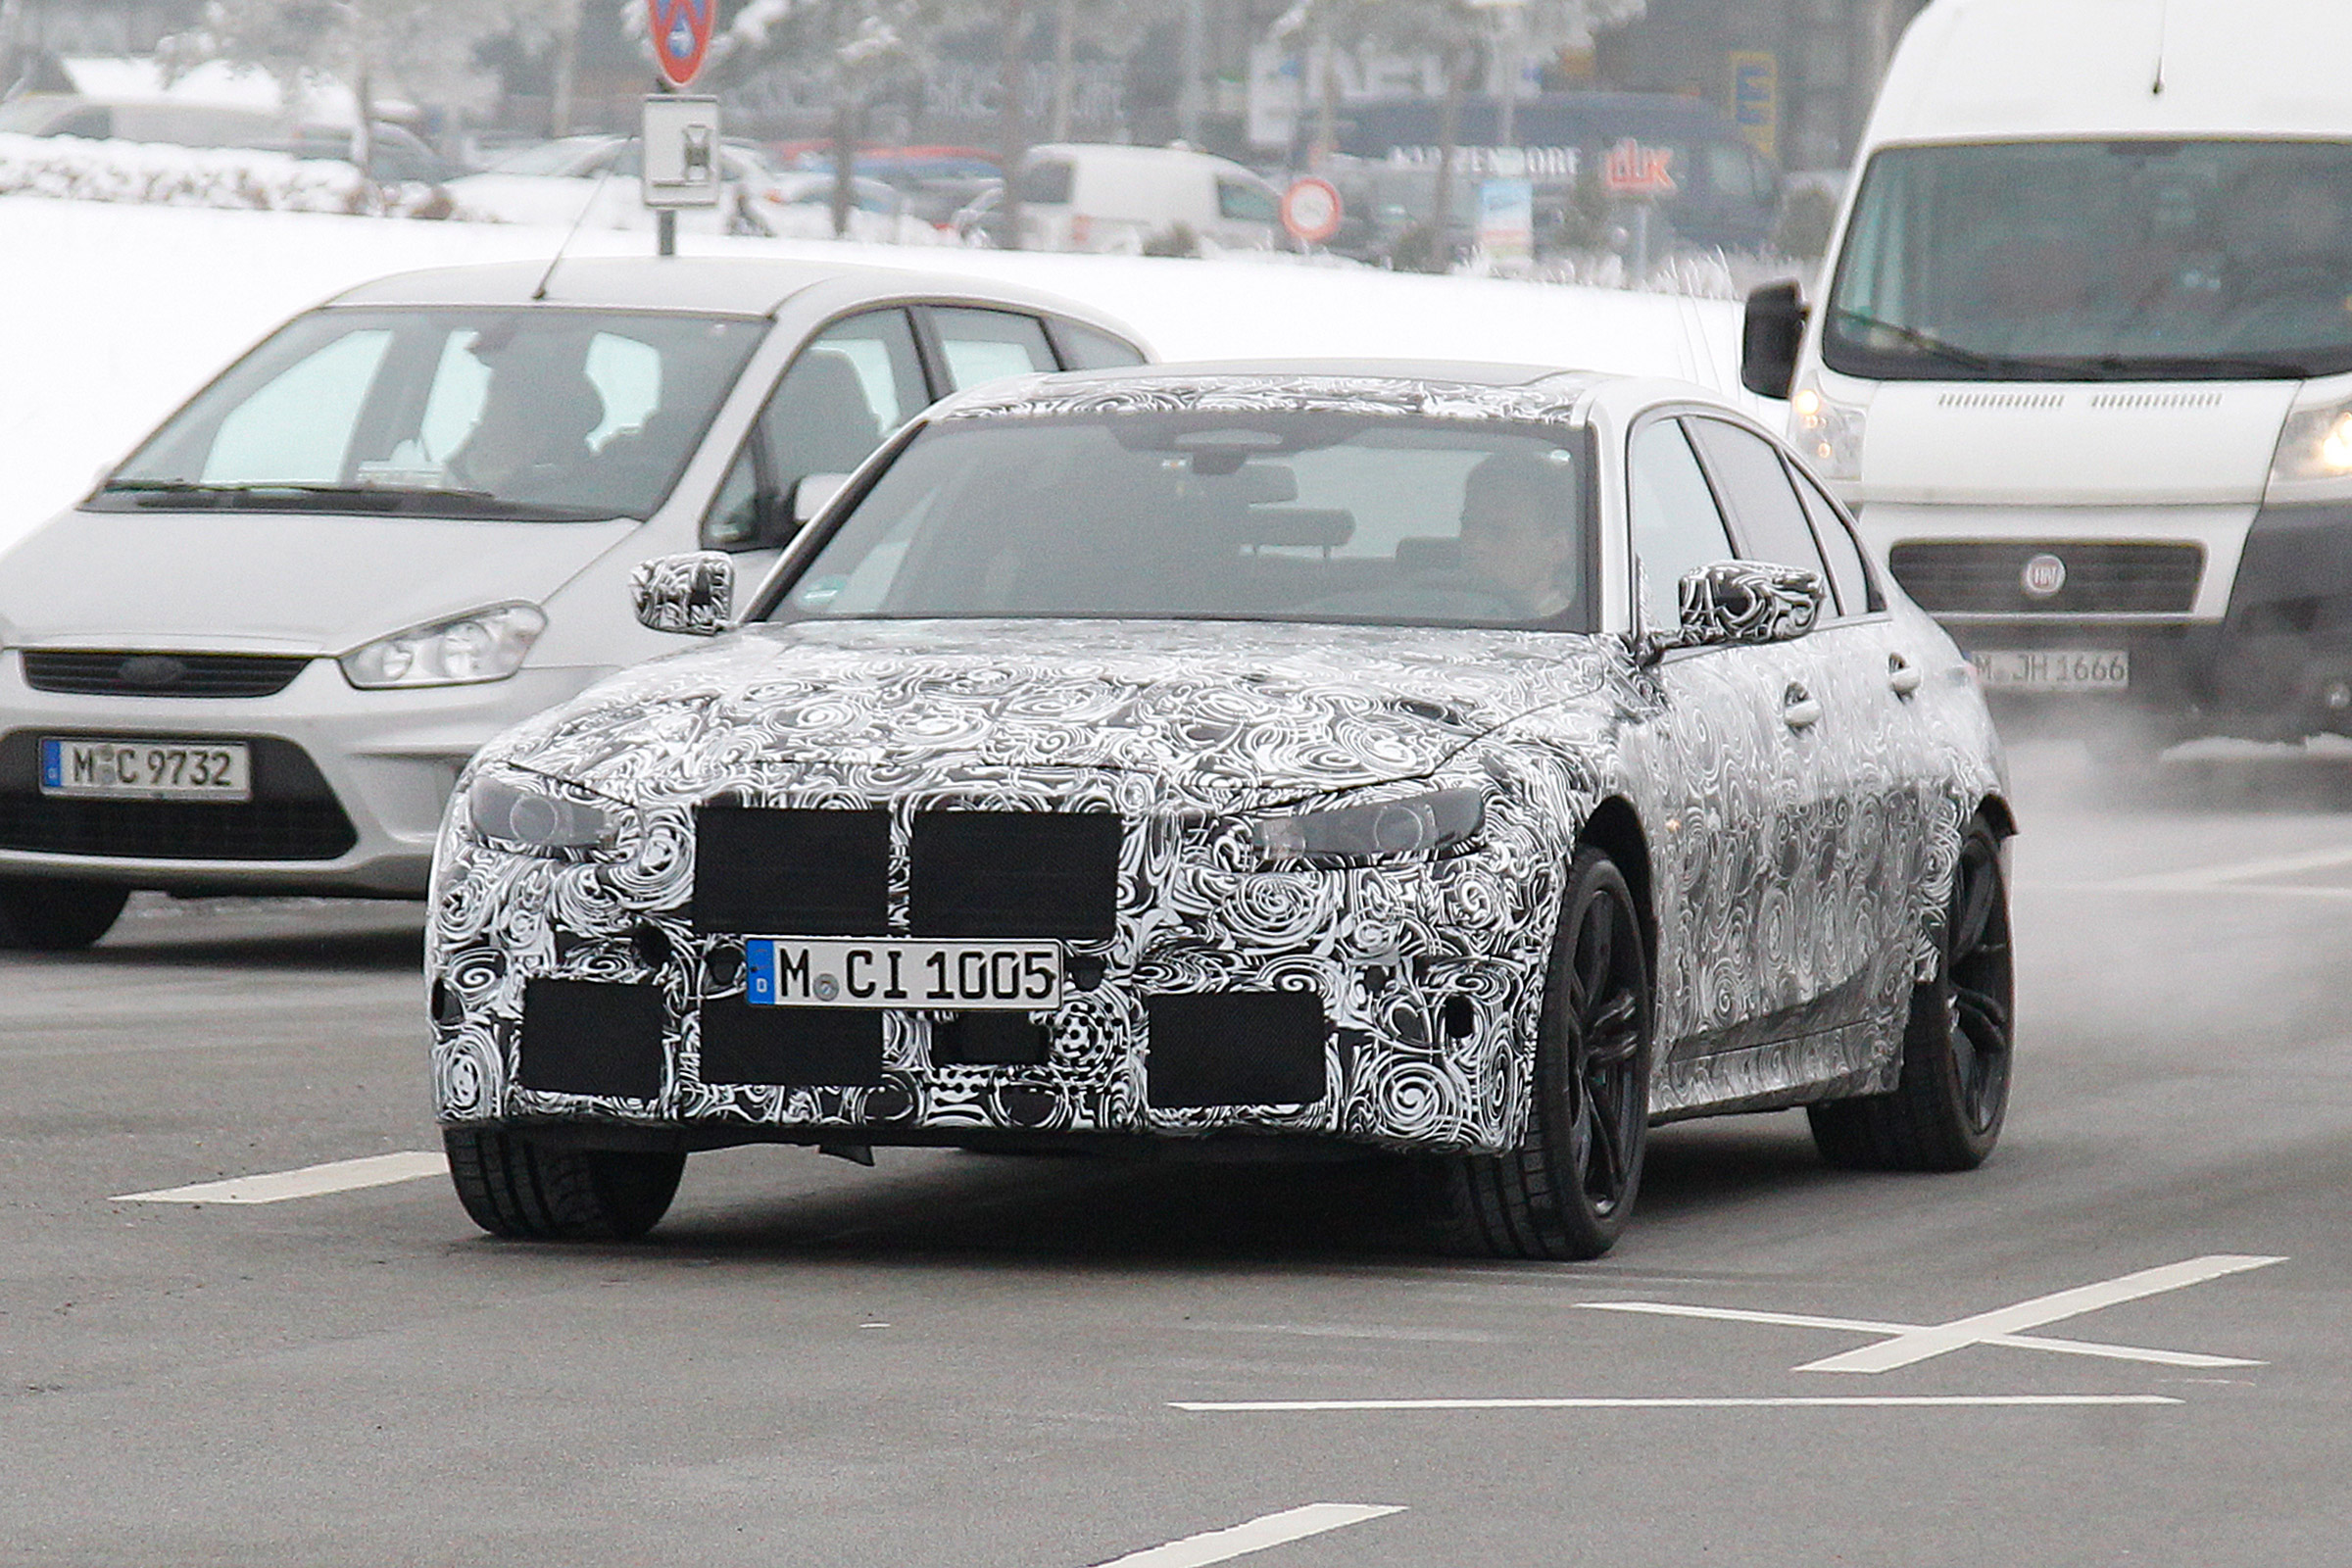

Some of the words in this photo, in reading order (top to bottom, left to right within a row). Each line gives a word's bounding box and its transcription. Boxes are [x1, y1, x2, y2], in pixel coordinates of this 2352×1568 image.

[1974, 654, 1993, 681] M
[2012, 654, 2049, 682] JH
[2056, 654, 2126, 683] 1666
[73, 747, 95, 783] M
[116, 749, 138, 784] C
[147, 749, 233, 787] 9732
[756, 977, 767, 993] D
[779, 948, 811, 998] M
[845, 949, 908, 1000] CI
[925, 951, 1058, 1001] 1005
